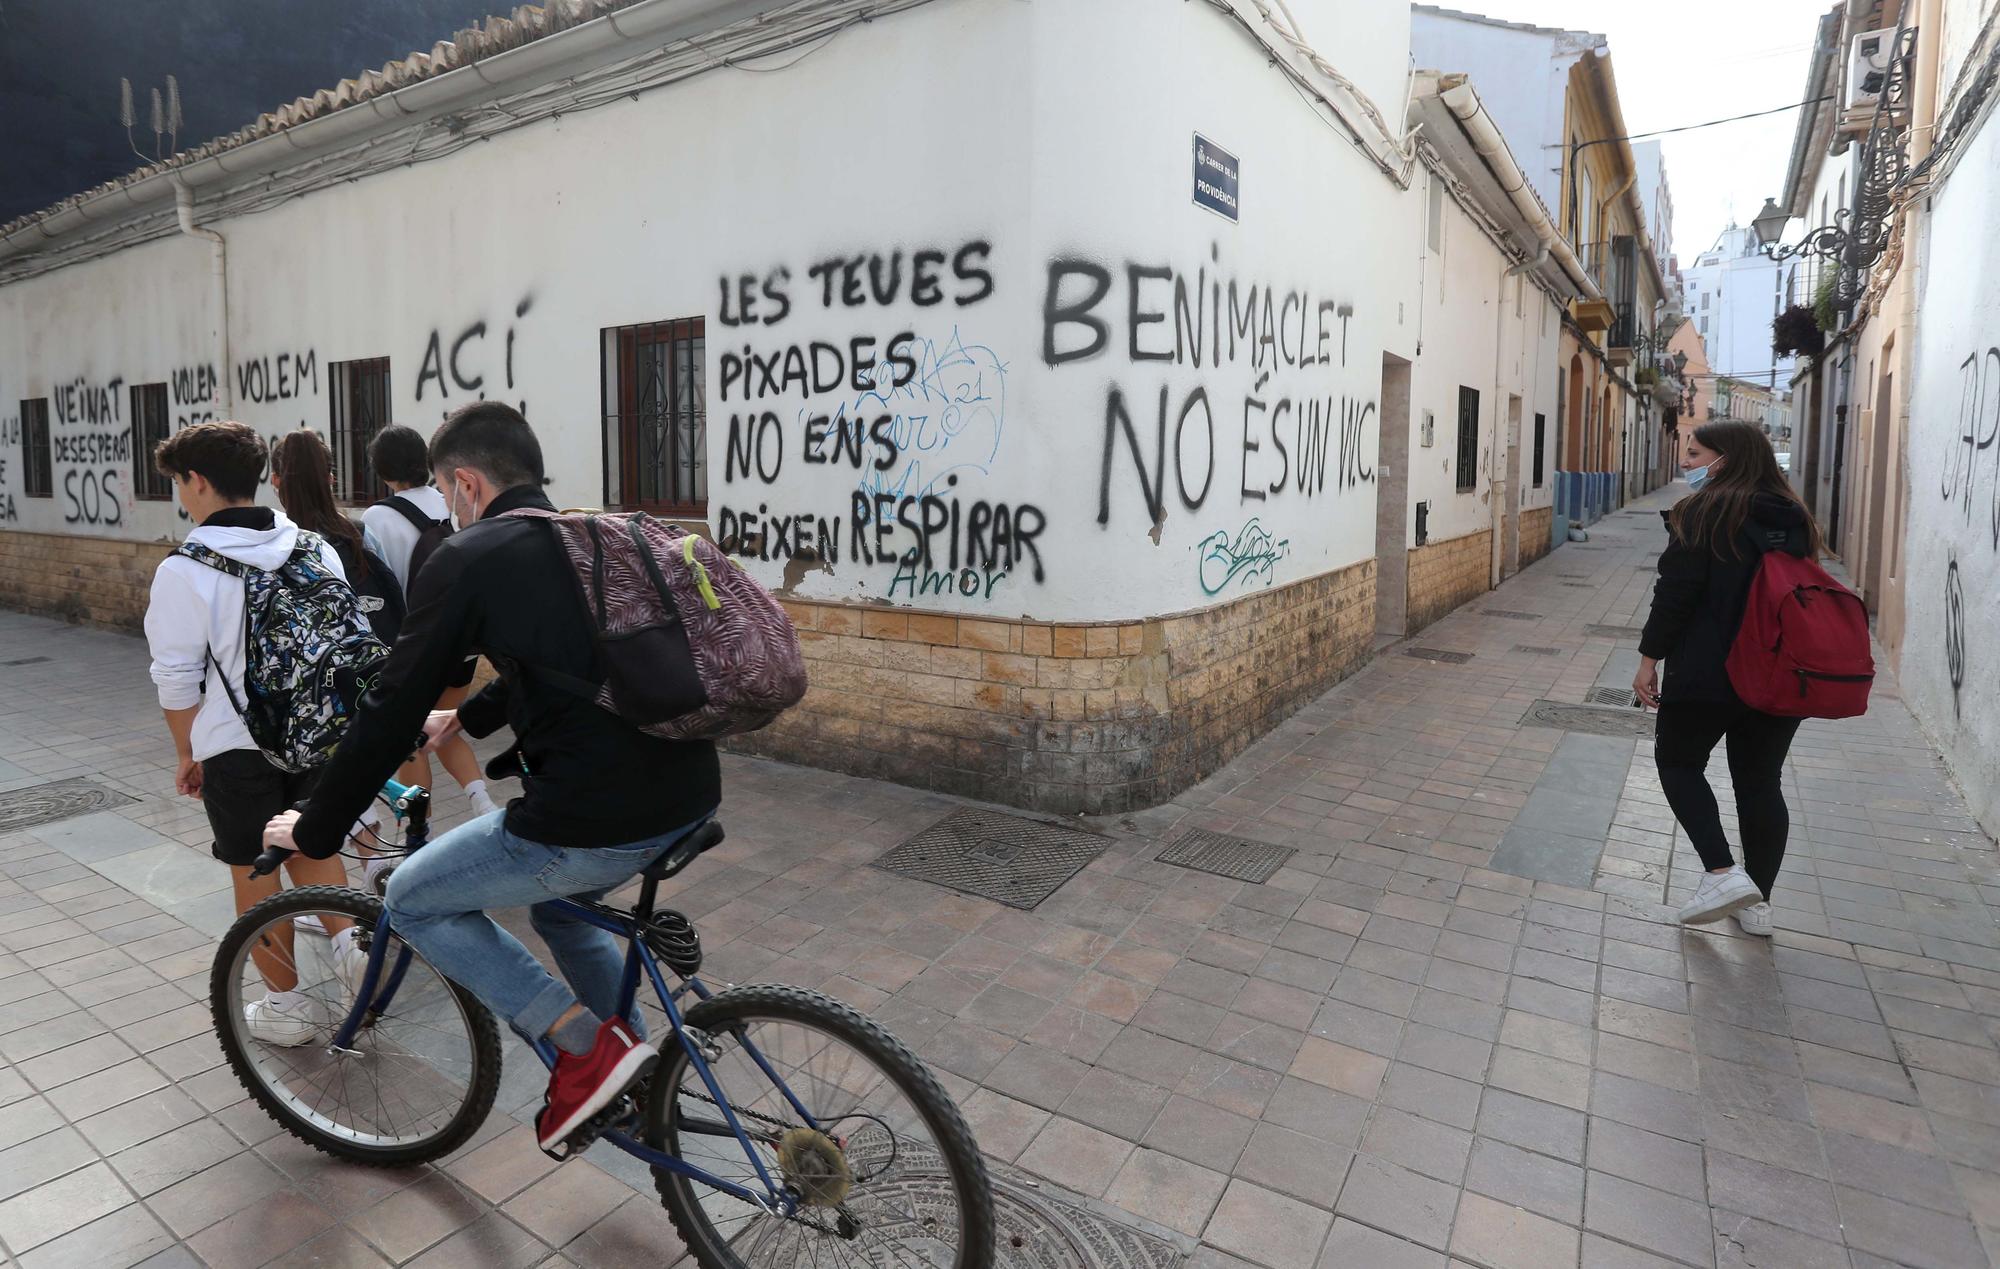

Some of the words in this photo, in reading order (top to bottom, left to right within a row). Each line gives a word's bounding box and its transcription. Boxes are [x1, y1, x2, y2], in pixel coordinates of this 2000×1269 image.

[1205, 156, 1224, 173] CARRER
[1224, 166, 1231, 177] DE
[1231, 170, 1237, 180] LA
[719, 267, 791, 326] LES
[238, 350, 318, 404] VOLEM
[55, 427, 131, 464] DESESPERAT
[725, 412, 783, 484] NO
[803, 415, 899, 471] ENS
[1097, 383, 1214, 530] NO
[1240, 371, 1291, 504] ÉS
[1297, 395, 1332, 498] UN
